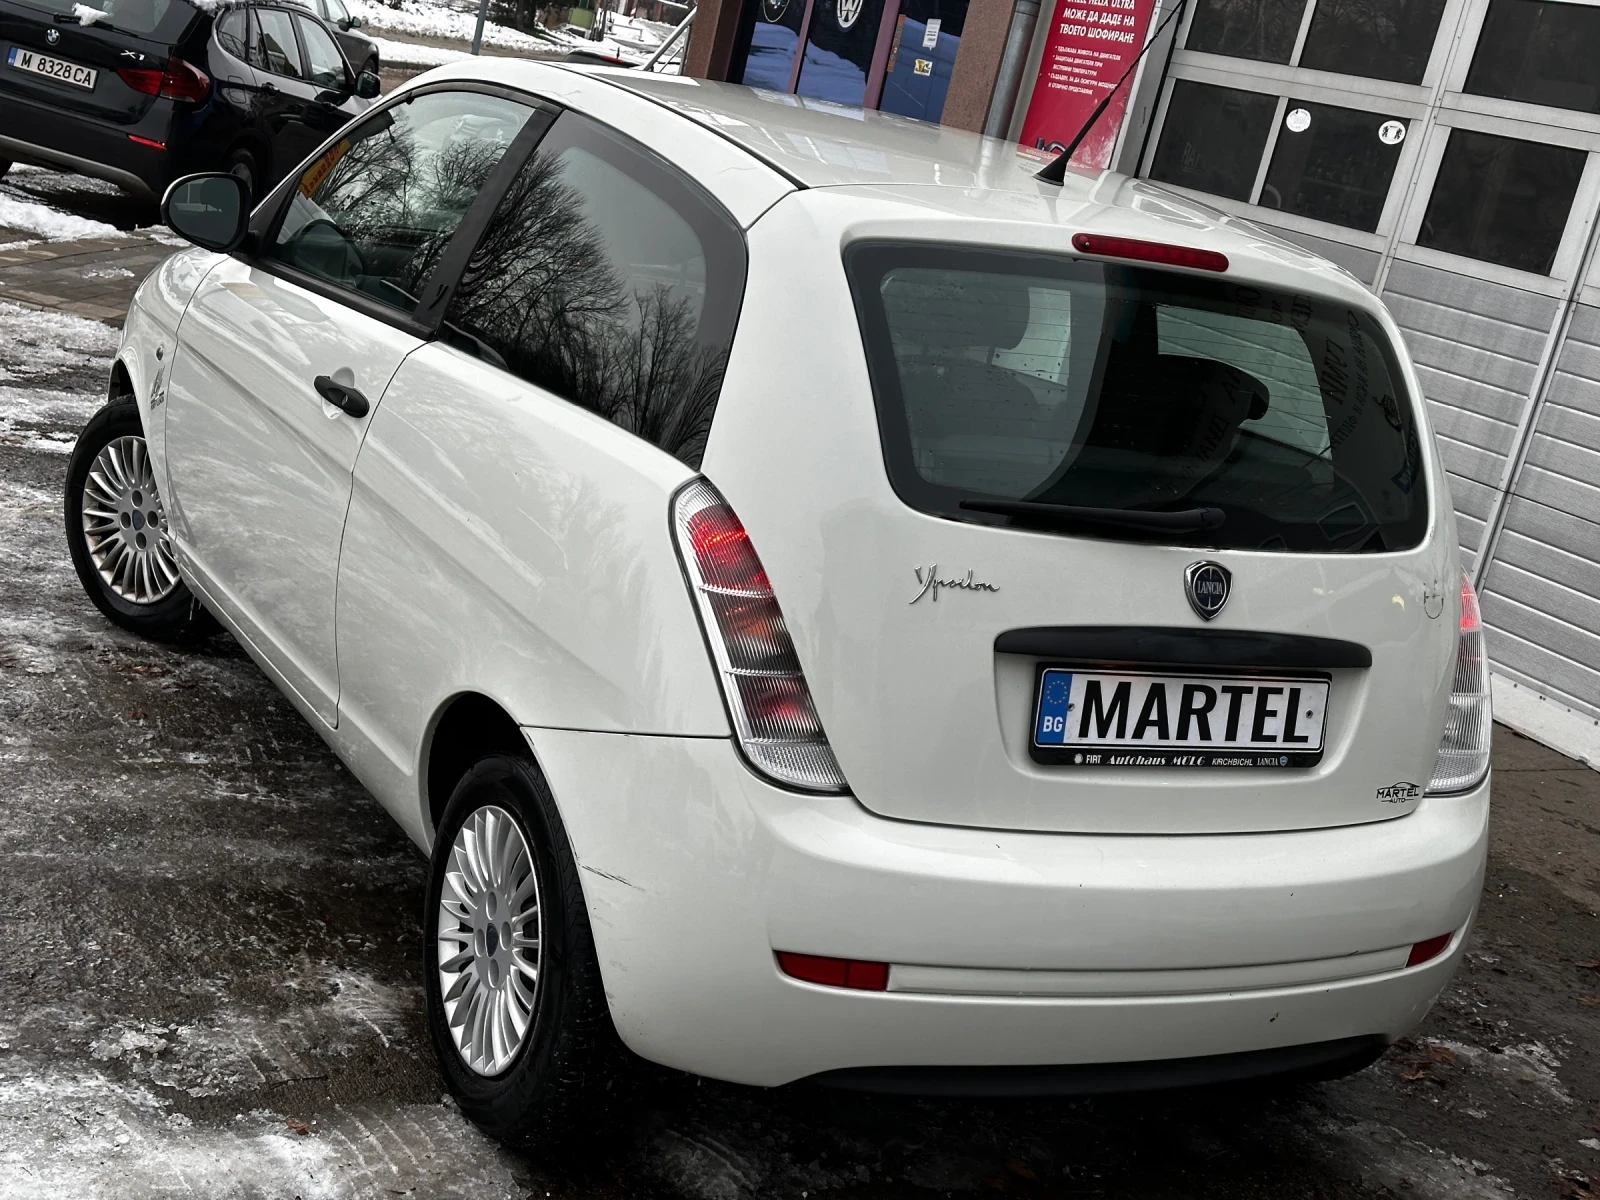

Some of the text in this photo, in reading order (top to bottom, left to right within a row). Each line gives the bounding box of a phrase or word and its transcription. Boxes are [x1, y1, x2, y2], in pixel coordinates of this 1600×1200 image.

[1112, 0, 1135, 10] ULTRA
[1063, 8, 1135, 27] МОЖЕ ДА ДАДЕ НА
[1060, 24, 1135, 44] ТВОЕТО ШОФИРАНЕ
[120, 49, 145, 61] X1
[21, 52, 92, 86] M 8328 CA
[908, 563, 1000, 605] Ypsilon
[1197, 580, 1223, 595] LANCIA
[1078, 679, 1309, 744] MARTEL
[1043, 716, 1063, 734] BG
[1086, 754, 1102, 764] FIAT
[1106, 755, 1167, 766] Autohaus
[1212, 758, 1254, 766] KIRCHBICHL
[1258, 758, 1279, 766] LANCIA
[1376, 788, 1420, 799] MARTEL
